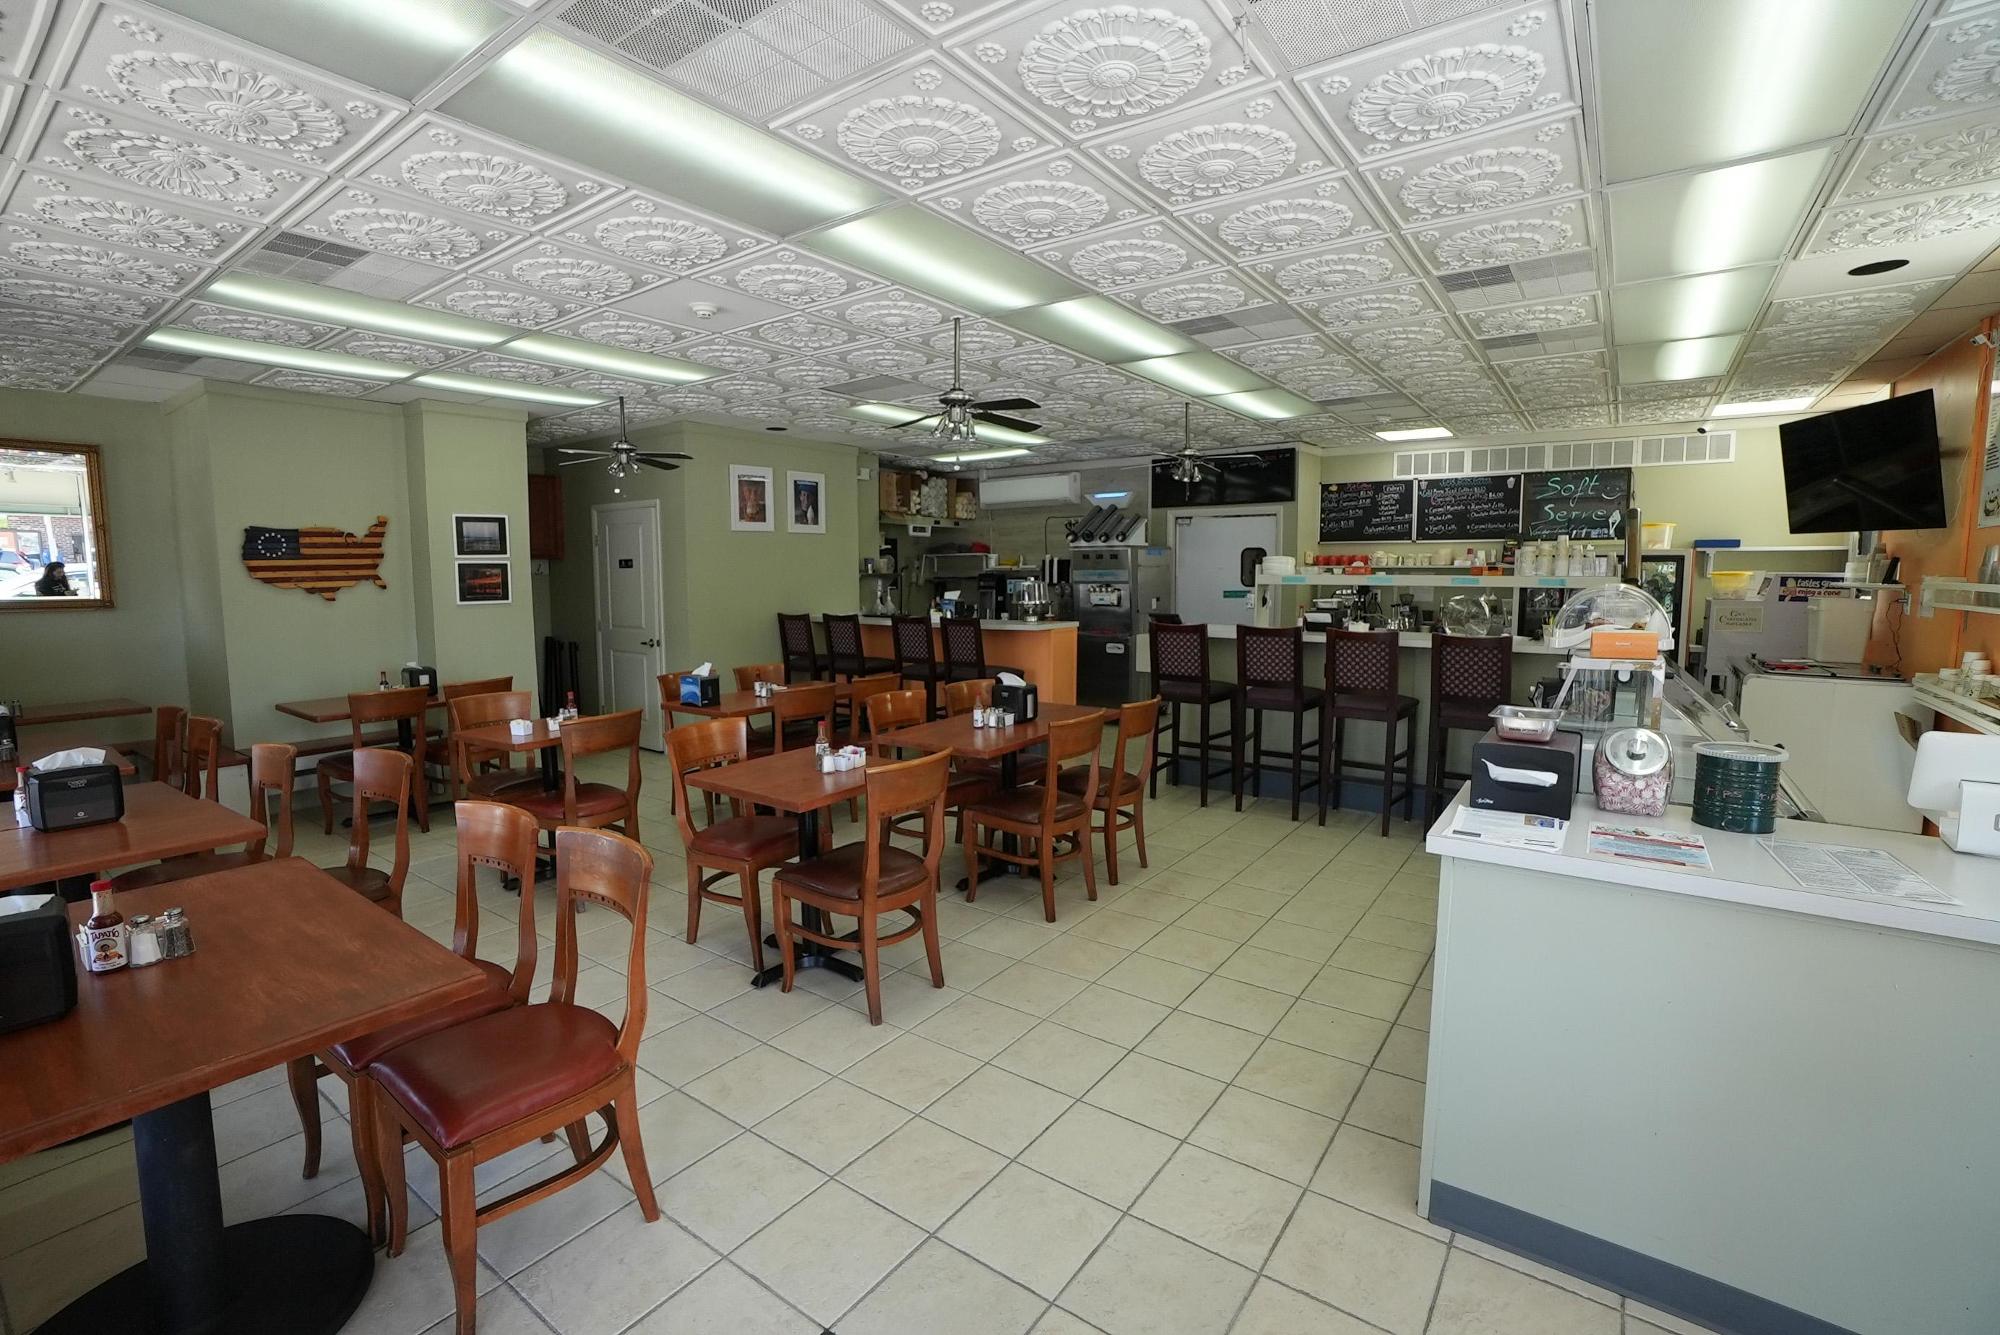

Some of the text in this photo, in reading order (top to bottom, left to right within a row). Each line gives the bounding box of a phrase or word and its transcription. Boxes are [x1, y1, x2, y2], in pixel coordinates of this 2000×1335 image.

[1536, 473, 1599, 507] Soft
[1531, 504, 1606, 525] Serve
[1797, 578, 1821, 588] tastes
[1823, 589, 1841, 597] cone
